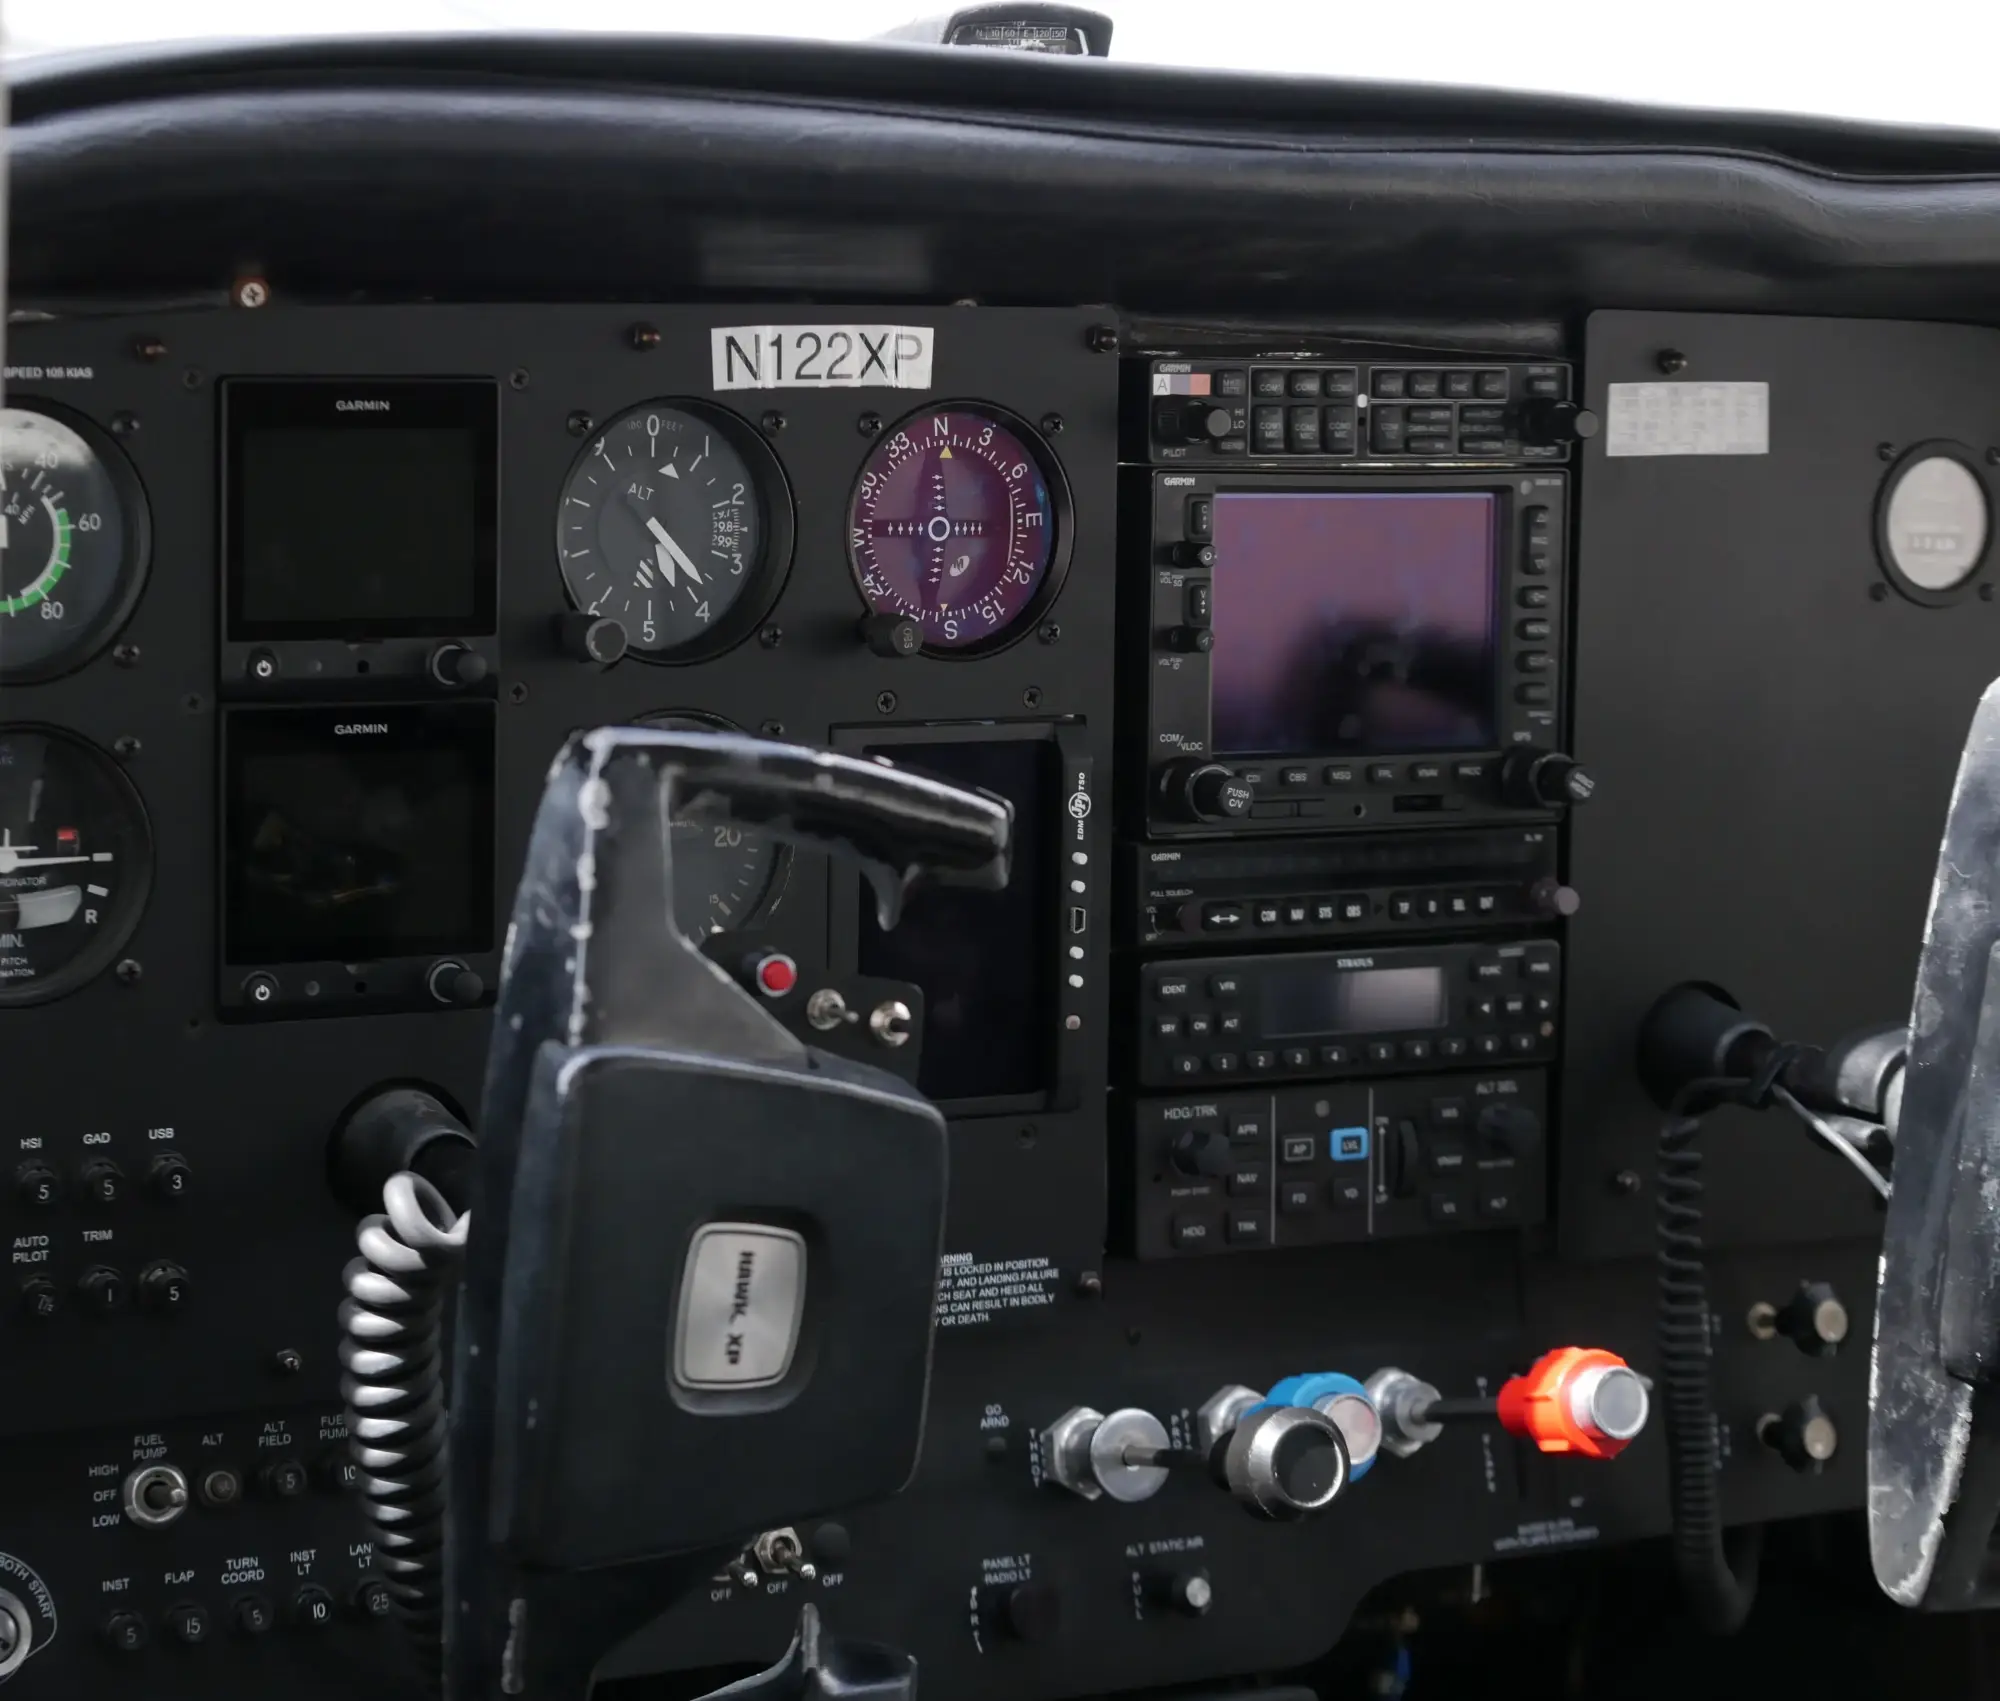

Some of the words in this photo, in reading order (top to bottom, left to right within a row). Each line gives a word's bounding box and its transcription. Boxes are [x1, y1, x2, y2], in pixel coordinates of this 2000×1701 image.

[725, 332, 924, 383] N122XP
[66, 366, 93, 378] KIAS
[1159, 364, 1191, 373] GARMIN
[1156, 377, 1168, 391] A
[335, 400, 390, 412] GARMIN
[646, 414, 661, 436] 0
[934, 416, 949, 437] N
[1232, 420, 1246, 430] LO
[978, 427, 996, 446] 3
[884, 431, 910, 459] 33
[33, 452, 58, 469] 40
[1162, 448, 1187, 458] PILOT
[1011, 462, 1029, 480] 6
[860, 471, 877, 500] 30
[1163, 476, 1196, 486] GARMIN
[627, 482, 655, 501] ALT
[731, 483, 745, 505] 2
[77, 513, 102, 532] 60
[1025, 511, 1043, 528] E
[852, 526, 865, 549] W
[730, 554, 743, 575] 3
[1012, 559, 1036, 586] 12
[862, 571, 885, 600] 24
[39, 601, 64, 620] 80
[695, 601, 710, 623] 4
[982, 599, 1007, 625] 15
[642, 620, 656, 643] 5
[943, 619, 959, 641] S
[334, 723, 388, 735] GARMIN
[1078, 772, 1086, 791] TSO
[1226, 787, 1250, 800] PUSH
[1228, 798, 1244, 809] C/V
[713, 824, 742, 847] 20
[1150, 852, 1182, 862] GARMIN
[85, 908, 99, 924] R
[1, 957, 29, 966] PITCH
[1336, 957, 1375, 969] STRATUS
[1161, 984, 1187, 996] IDENT
[1160, 1023, 1176, 1033] SBY
[1193, 1021, 1207, 1031] ON
[1223, 1018, 1239, 1028] ALT
[1163, 1104, 1218, 1120] HDG/TRK
[148, 1128, 175, 1140] USB
[1237, 1124, 1258, 1135] APR
[20, 1137, 42, 1149] HSI
[83, 1132, 111, 1145] GAD
[172, 1174, 183, 1190] 3
[1237, 1173, 1258, 1184] NAV
[37, 1184, 50, 1200] 5
[103, 1179, 115, 1196] 5
[1182, 1225, 1206, 1237] HDG
[1237, 1221, 1257, 1232] TRK
[13, 1235, 50, 1248] AUTO
[82, 1229, 113, 1242] TRIM
[12, 1250, 50, 1263] PILOT
[940, 1252, 974, 1265] RNING
[954, 1263, 992, 1276] LOCKED
[1005, 1257, 1049, 1271] POSITION
[957, 1277, 977, 1288] AND
[978, 1272, 1020, 1286] LANDING
[1020, 1268, 1060, 1281] FAILURE
[169, 1286, 180, 1301] 5
[729, 1251, 755, 1325] HAWK
[952, 1289, 977, 1301] SEAT
[979, 1286, 1000, 1298] AND
[1000, 1284, 1026, 1296] HEED
[1027, 1282, 1044, 1293] ALL
[950, 1302, 971, 1313] CAN
[972, 1298, 1008, 1312] RESULT
[1021, 1292, 1056, 1306] BODILY
[941, 1315, 956, 1327] OR
[957, 1312, 991, 1325] DEATH.
[725, 1333, 744, 1366] XP
[985, 1404, 1002, 1415] GO
[263, 1420, 285, 1433] ALT
[320, 1414, 344, 1428] FUE
[980, 1415, 1010, 1430] ARND
[134, 1435, 164, 1447] FUEL
[201, 1433, 224, 1446] ALT
[258, 1433, 292, 1447] FIELD
[132, 1447, 167, 1461] PUMP
[88, 1464, 119, 1478] HIGH
[286, 1473, 296, 1490] 5
[93, 1490, 117, 1502] OFF
[92, 1513, 121, 1528] LOW
[349, 1542, 374, 1556] LAN
[1125, 1542, 1145, 1557] ALT
[1148, 1537, 1185, 1555] STATIC
[1186, 1535, 1204, 1549] AIR
[226, 1556, 259, 1570] TURN
[290, 1549, 316, 1563] INST
[358, 1555, 372, 1568] LT
[982, 1556, 1017, 1571] PANEL
[1018, 1553, 1032, 1567] LT
[296, 1562, 311, 1576] LT
[164, 1570, 195, 1584] FLAP
[221, 1570, 265, 1585] COORD
[822, 1573, 844, 1587] OFF
[984, 1570, 1017, 1586] RADIO
[1018, 1568, 1032, 1581] LT
[102, 1578, 130, 1592] INST
[766, 1580, 788, 1594] OFF
[28, 1579, 53, 1618] START
[372, 1592, 389, 1611] 25
[710, 1587, 732, 1602] OFF
[252, 1609, 263, 1625] 5
[312, 1603, 326, 1619] 10
[186, 1617, 200, 1634] 15
[126, 1628, 137, 1644] 5
